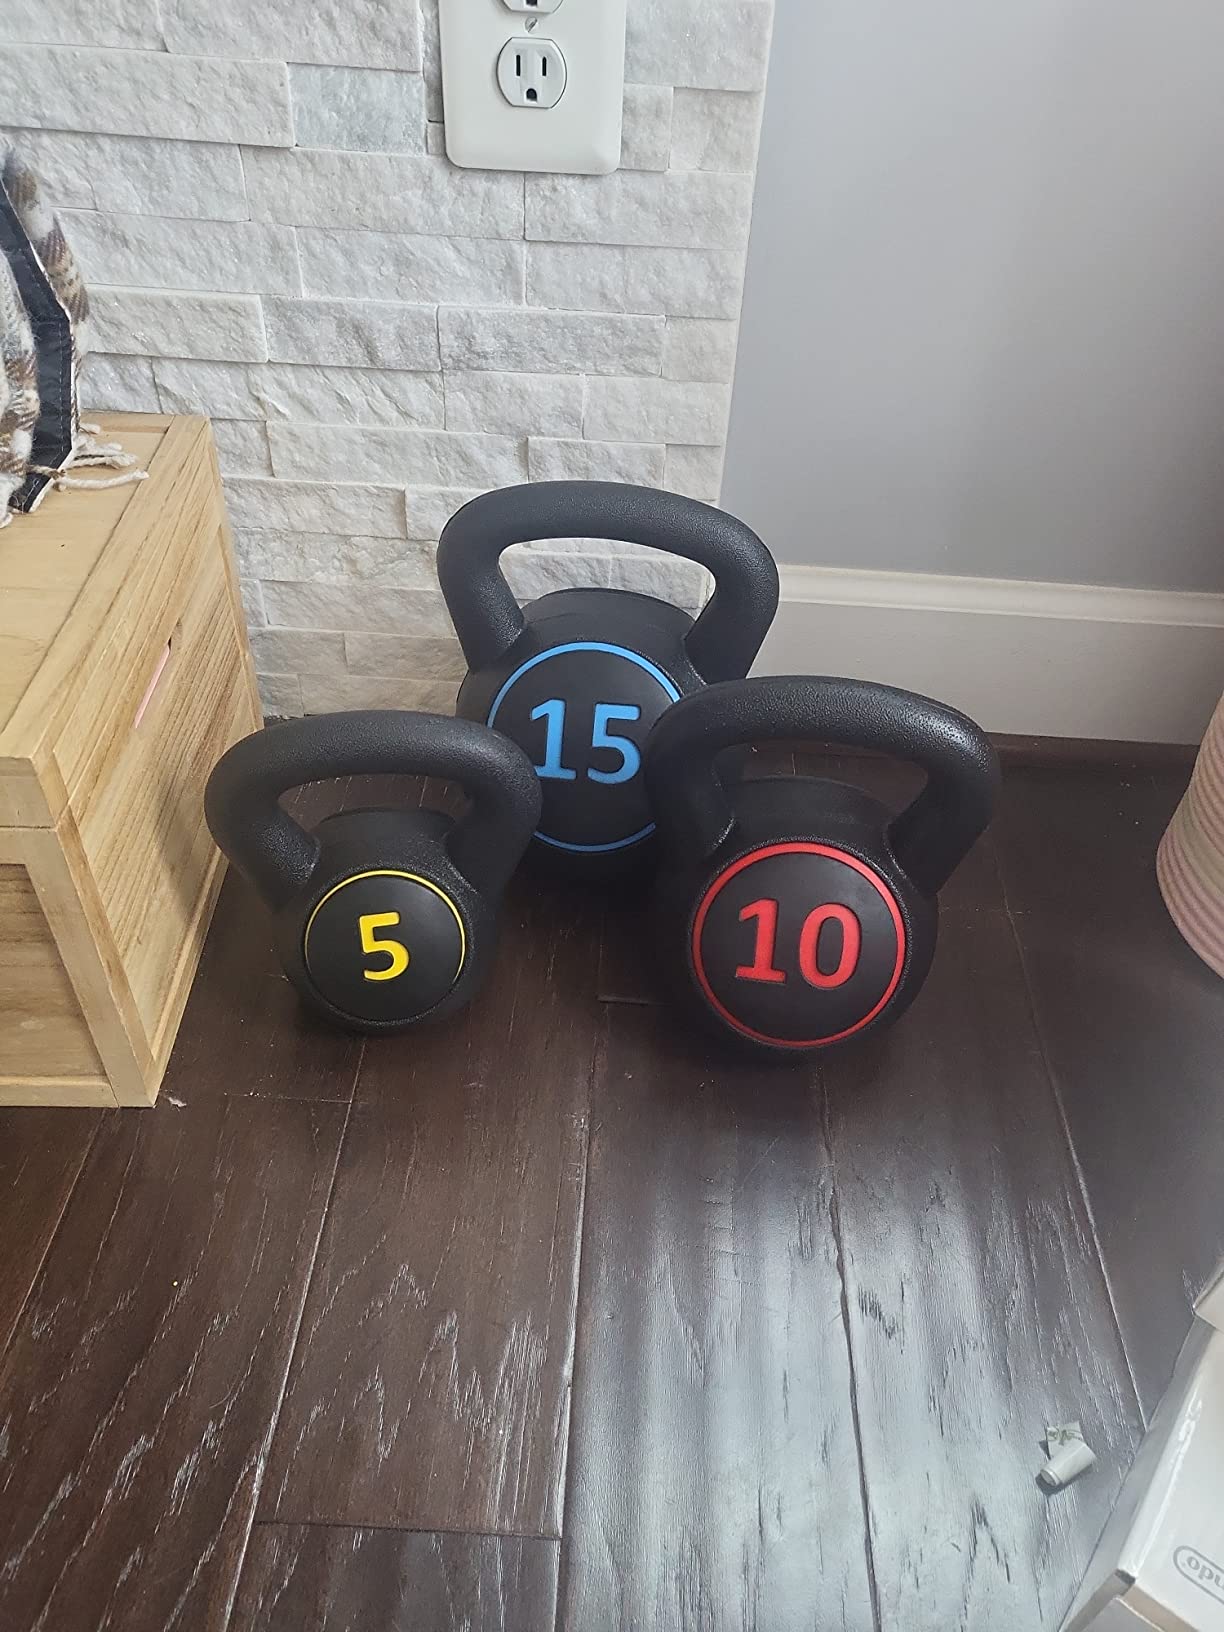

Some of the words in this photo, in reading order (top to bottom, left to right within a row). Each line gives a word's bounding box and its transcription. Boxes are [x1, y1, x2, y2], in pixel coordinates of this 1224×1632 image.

[529, 698, 642, 785] 15
[358, 911, 410, 981] 5
[734, 898, 861, 990] 10
